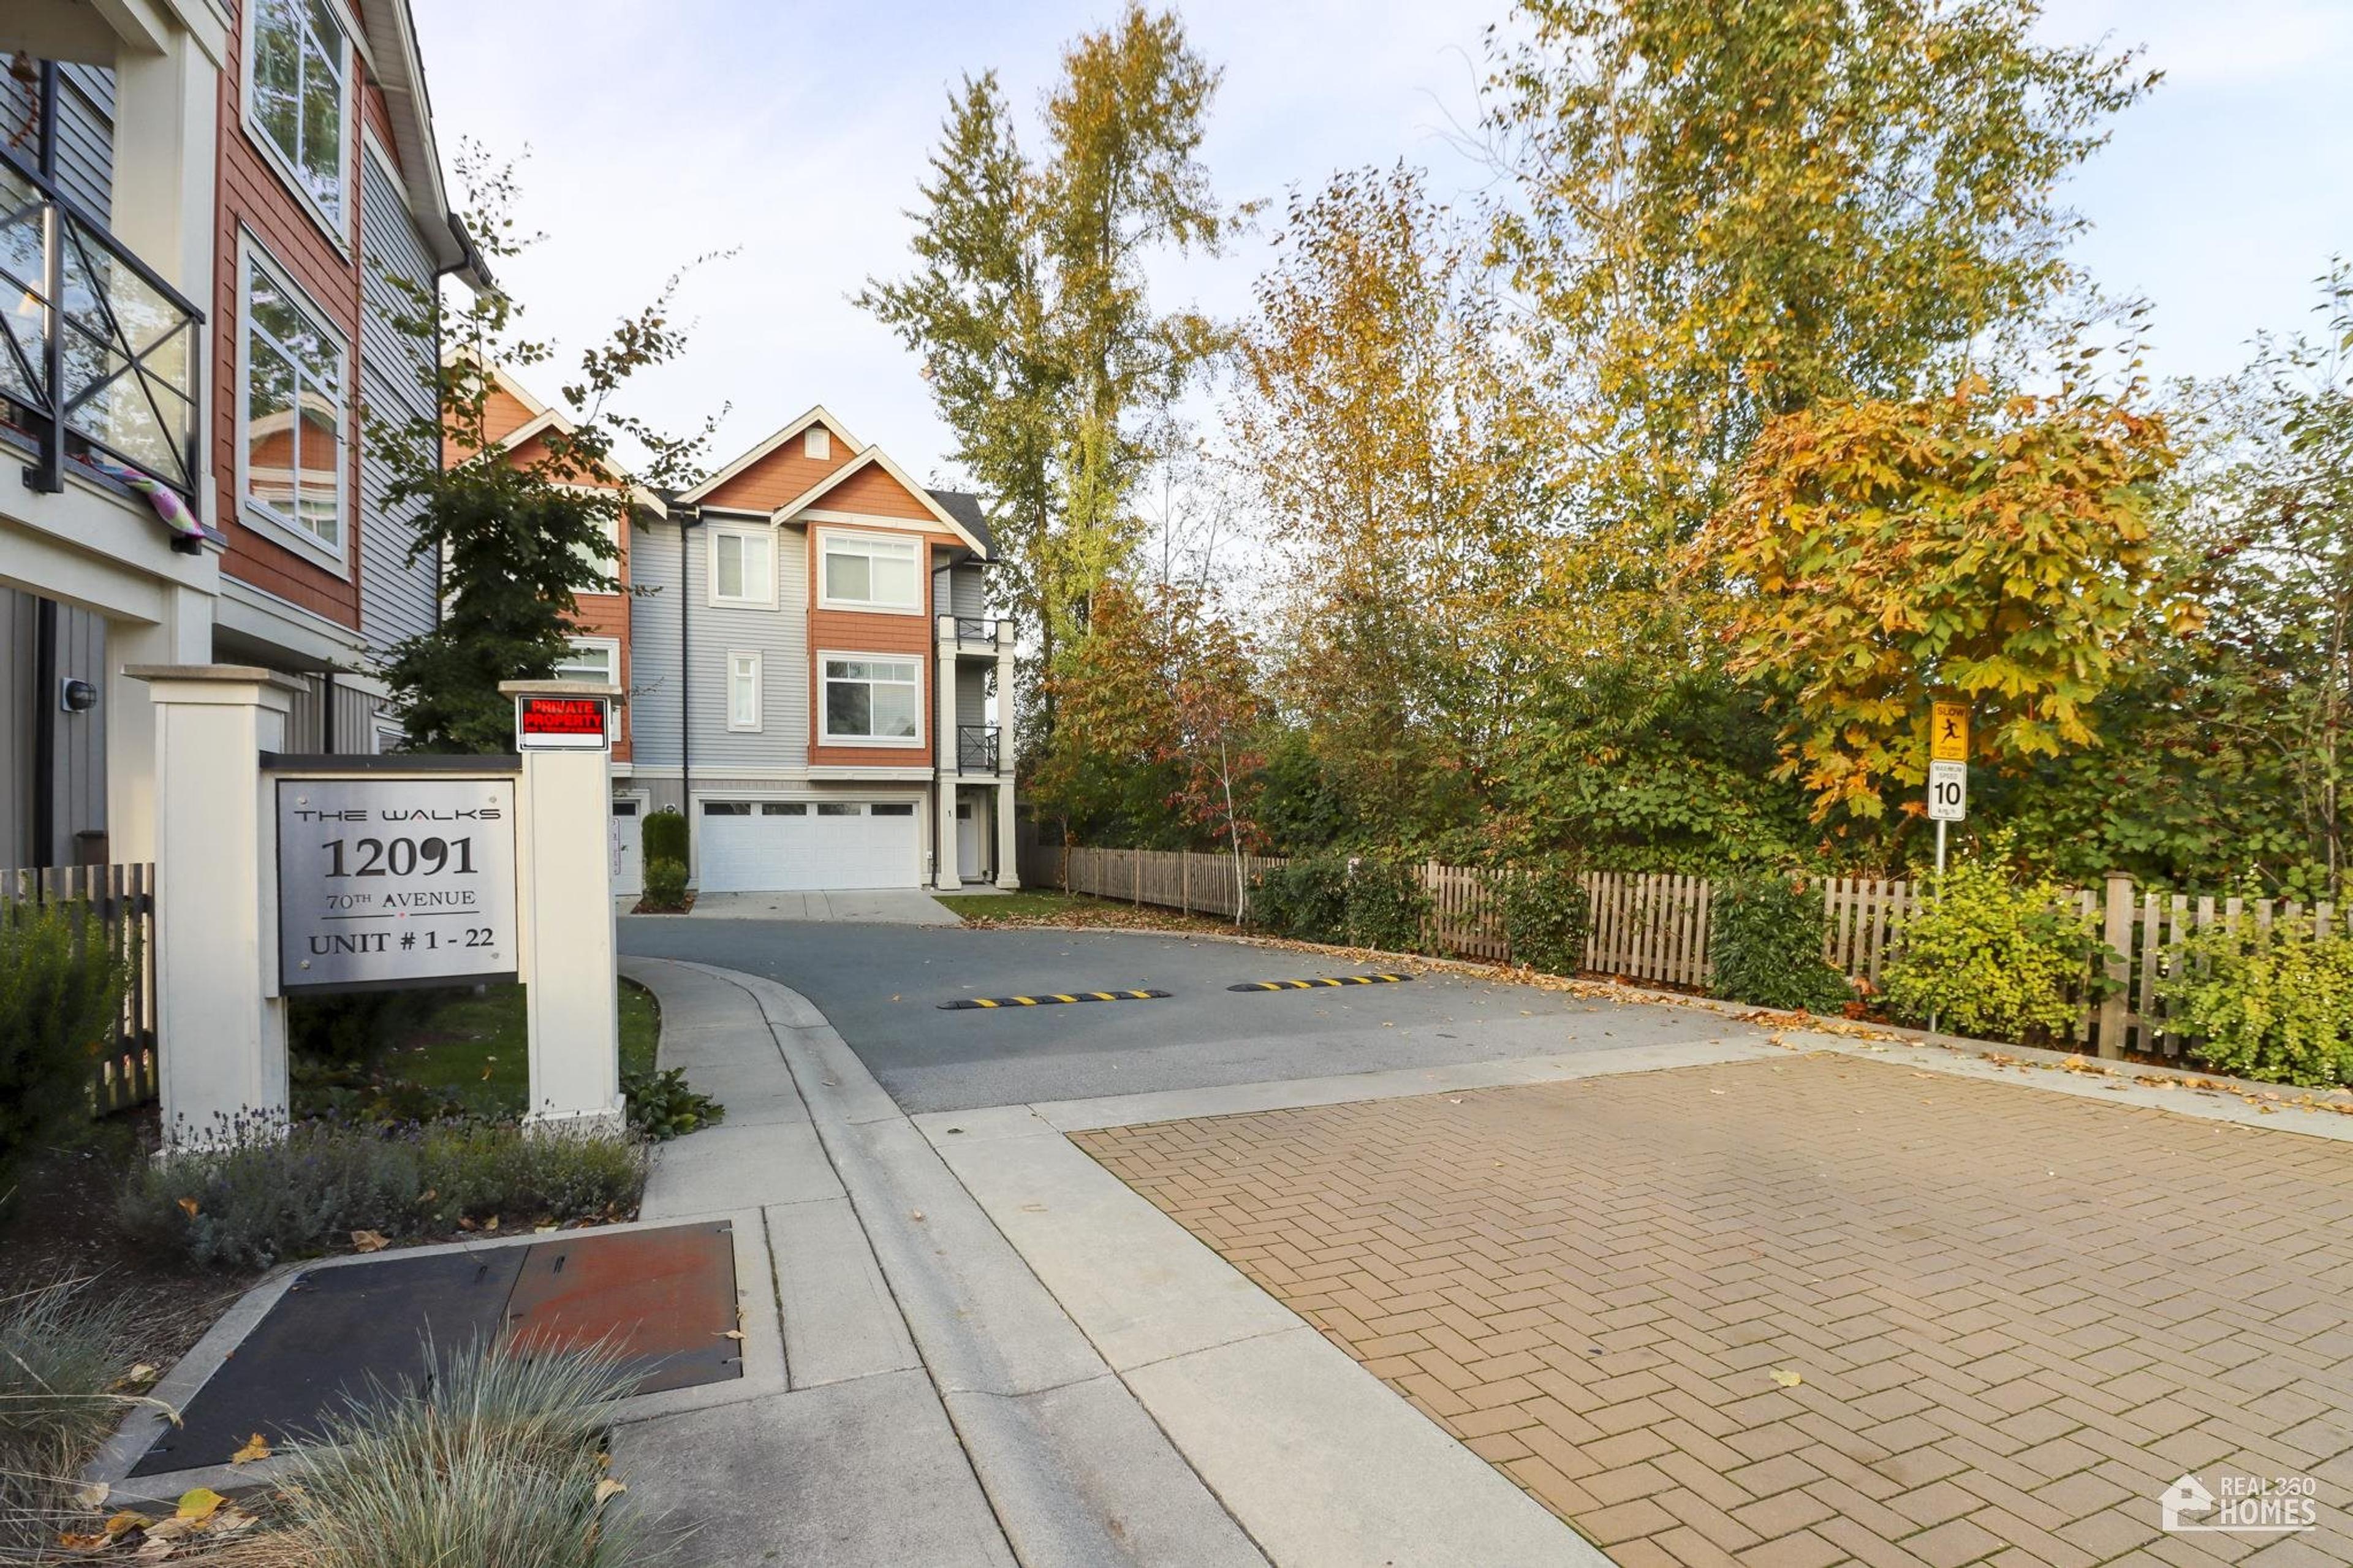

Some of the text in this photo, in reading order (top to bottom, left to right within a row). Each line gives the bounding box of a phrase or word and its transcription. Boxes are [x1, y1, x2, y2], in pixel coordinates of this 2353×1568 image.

[532, 700, 594, 714] PRIVATE
[1938, 706, 1965, 716] SLOW
[524, 713, 602, 727] PROPERTY
[1934, 782, 1960, 805] 10
[294, 808, 501, 822] THE WALKS
[322, 837, 478, 877] 12091
[326, 890, 476, 910] 70TH AVENUE
[308, 933, 391, 955] UNIT
[425, 931, 439, 949] 1
[465, 928, 494, 947] 22
